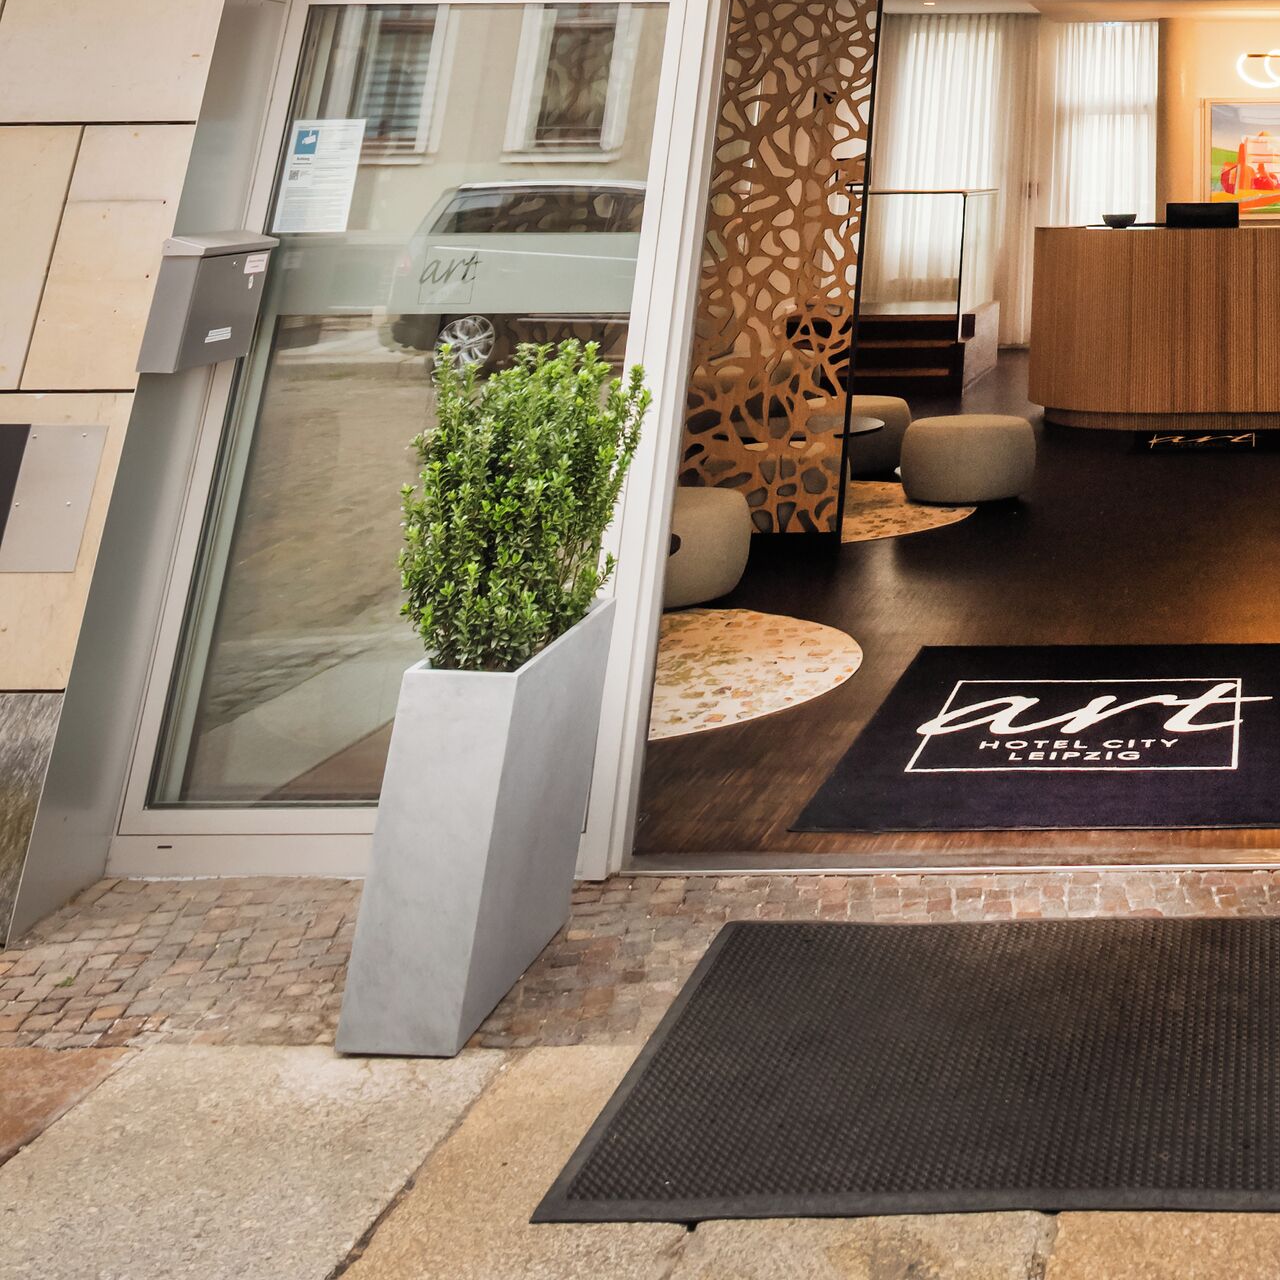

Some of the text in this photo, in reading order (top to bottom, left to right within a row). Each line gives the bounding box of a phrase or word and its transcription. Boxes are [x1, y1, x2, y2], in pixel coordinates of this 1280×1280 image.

[419, 251, 483, 284] art
[916, 682, 1272, 735] art
[978, 738, 1179, 750] HOTEL CITY
[1008, 750, 1141, 761] LEIPZIG
